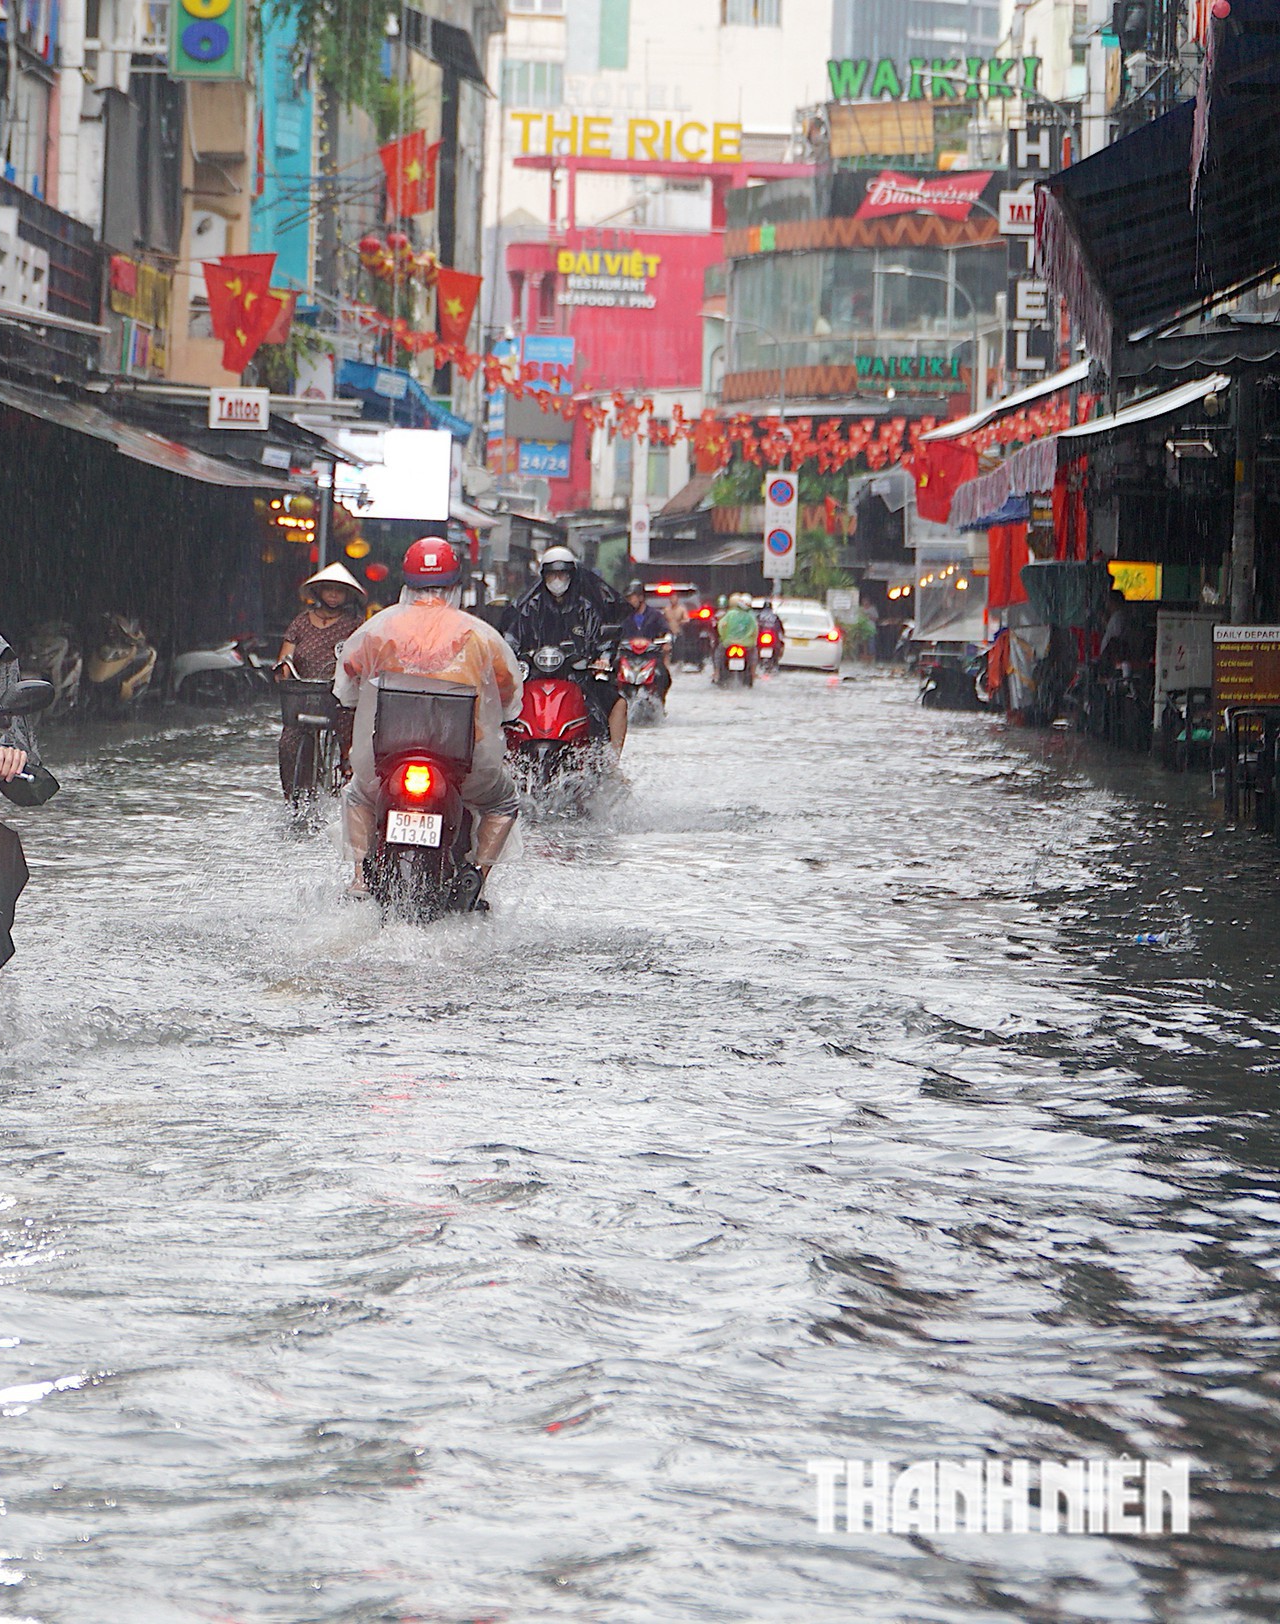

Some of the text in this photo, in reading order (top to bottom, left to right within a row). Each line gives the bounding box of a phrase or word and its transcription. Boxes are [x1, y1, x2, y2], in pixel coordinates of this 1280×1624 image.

[827, 57, 1042, 99] WAIKIKI
[511, 112, 743, 163] THE RICE
[867, 176, 981, 207] Budweiser
[604, 248, 661, 279] VIỆT
[568, 277, 646, 291] RESTAURANT
[558, 292, 616, 306] SEAFOOD
[855, 355, 960, 378] WAIKIKI
[218, 396, 260, 418] Tattoo
[521, 456, 567, 471] 24/24
[1216, 631, 1280, 640] DAILY DEPART
[396, 813, 434, 829] 50-AB
[391, 827, 437, 845] 413.48
